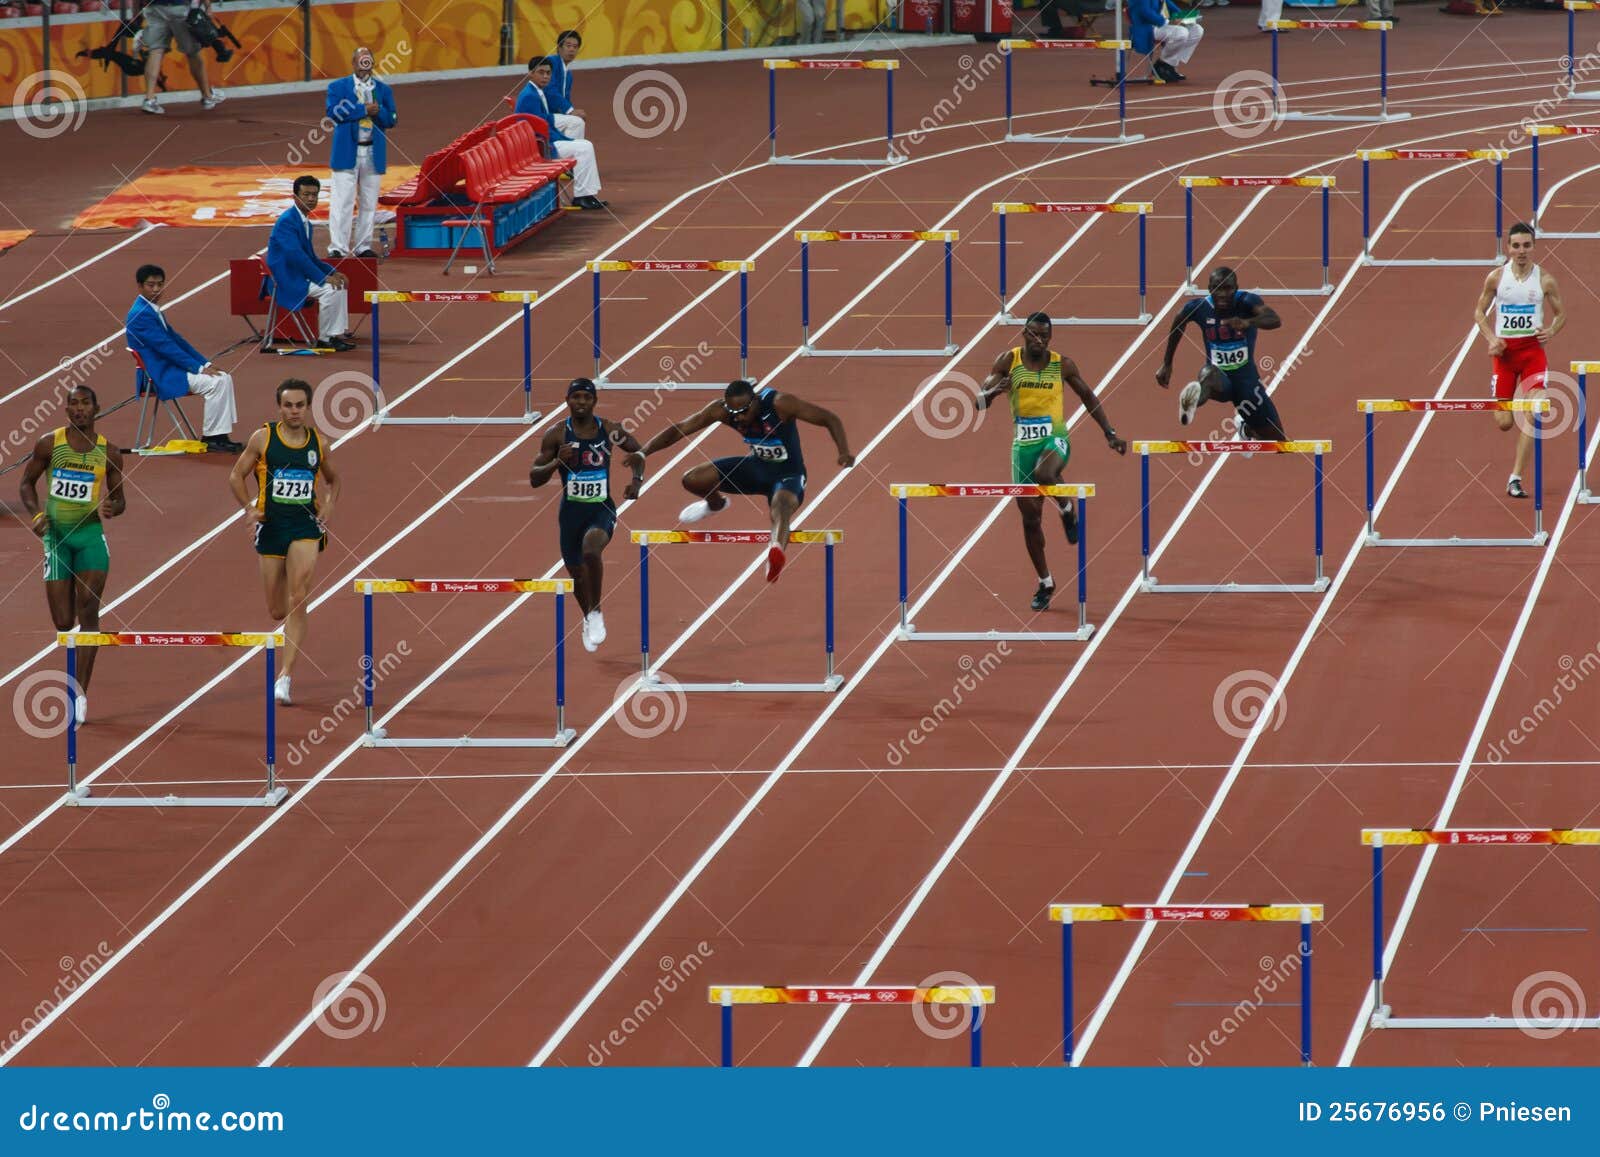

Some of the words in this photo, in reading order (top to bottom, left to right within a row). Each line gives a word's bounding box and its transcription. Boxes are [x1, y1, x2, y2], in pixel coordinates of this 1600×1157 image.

[1503, 315, 1533, 329] 2605
[1216, 350, 1244, 365] 3149
[1021, 425, 1048, 441] 2150
[55, 481, 88, 499] 2159
[276, 482, 310, 497] 2734
[572, 482, 602, 496] 3183
